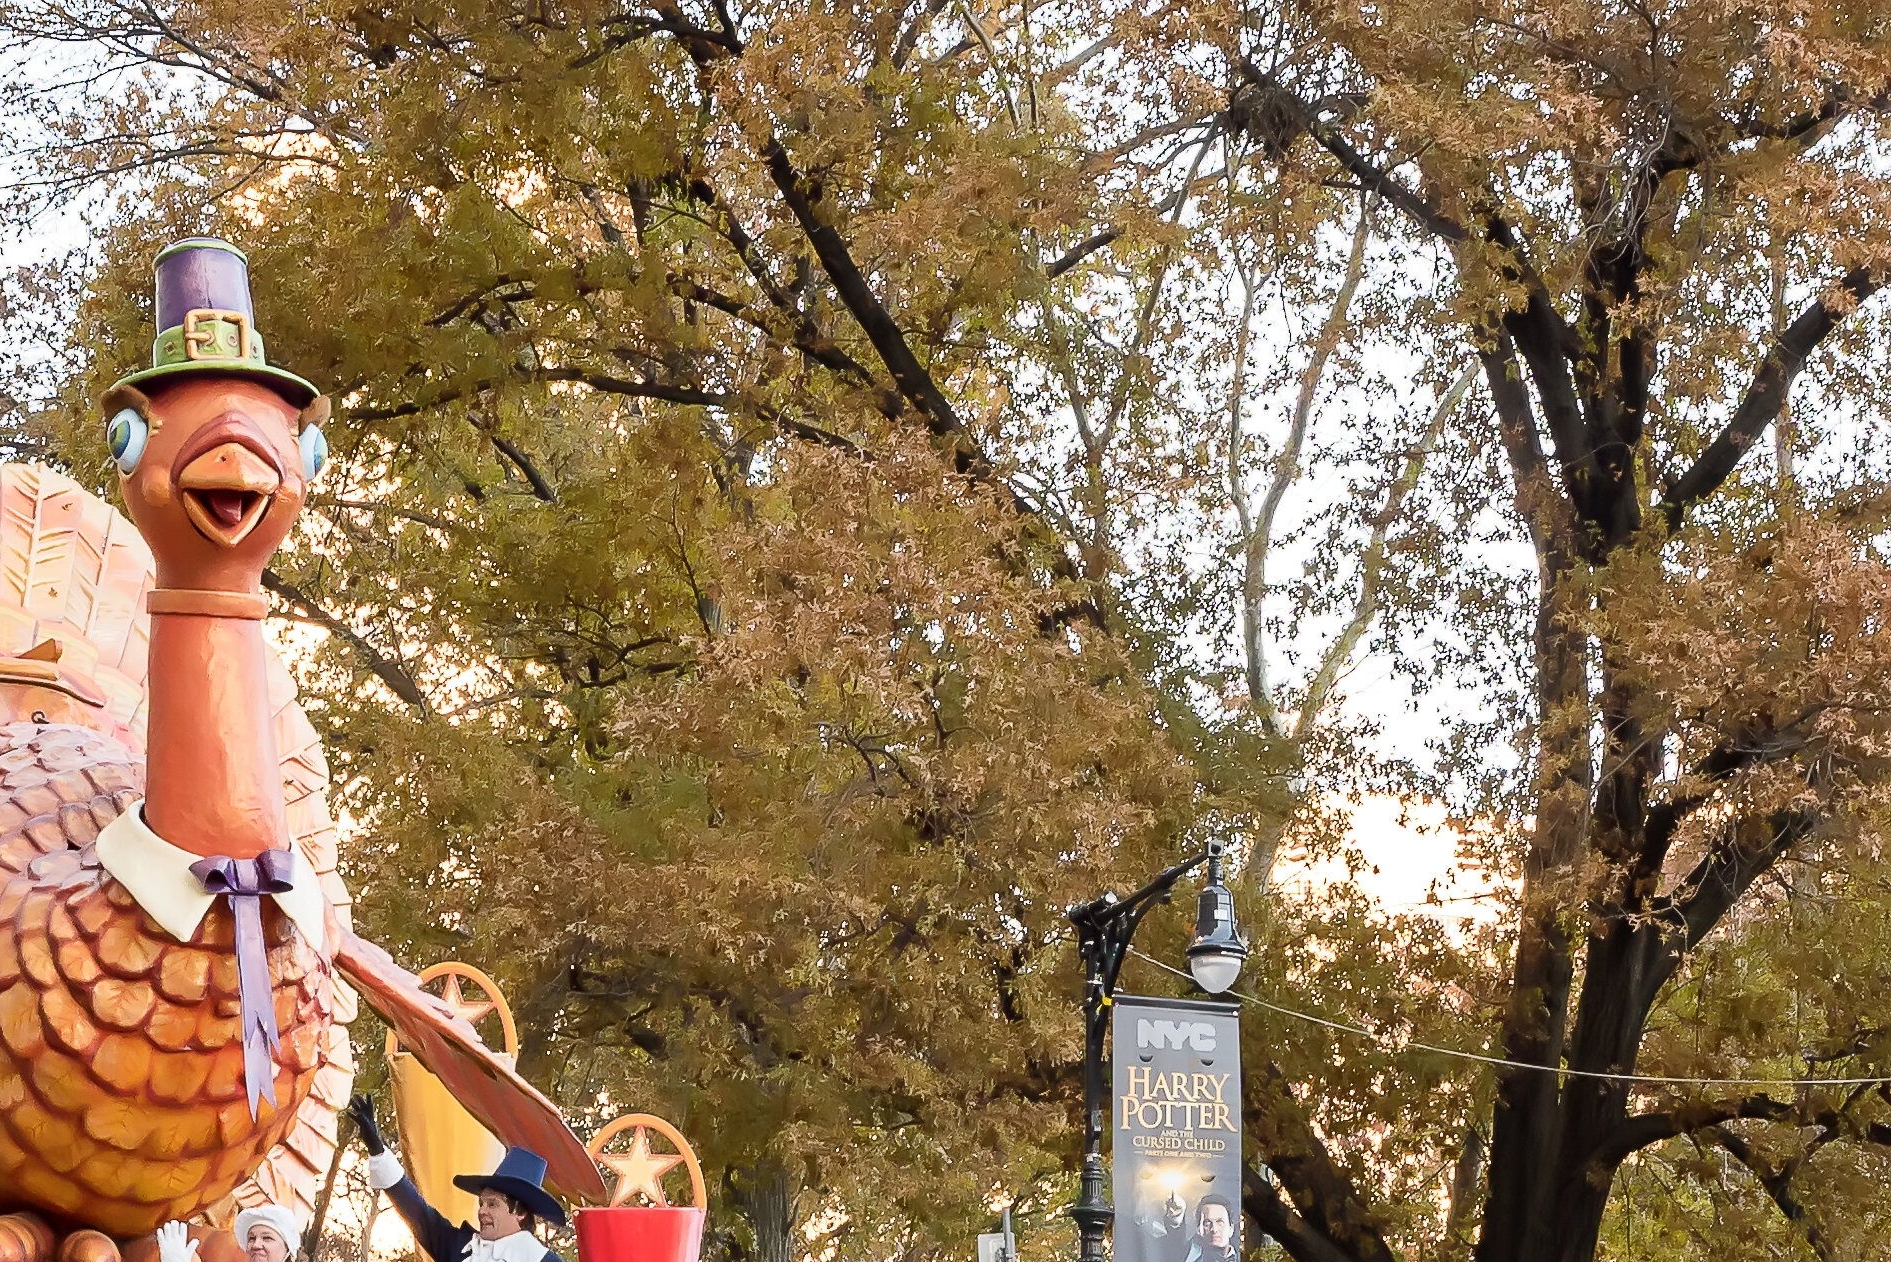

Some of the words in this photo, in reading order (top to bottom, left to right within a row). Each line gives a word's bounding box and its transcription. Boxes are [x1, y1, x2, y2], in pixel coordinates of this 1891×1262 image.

[1137, 1018, 1217, 1052] NYC
[1127, 1065, 1231, 1103] HARRY
[1120, 1095, 1238, 1133] POTTER
[1132, 1135, 1182, 1149] CURSED
[1184, 1137, 1226, 1151] CHILD
